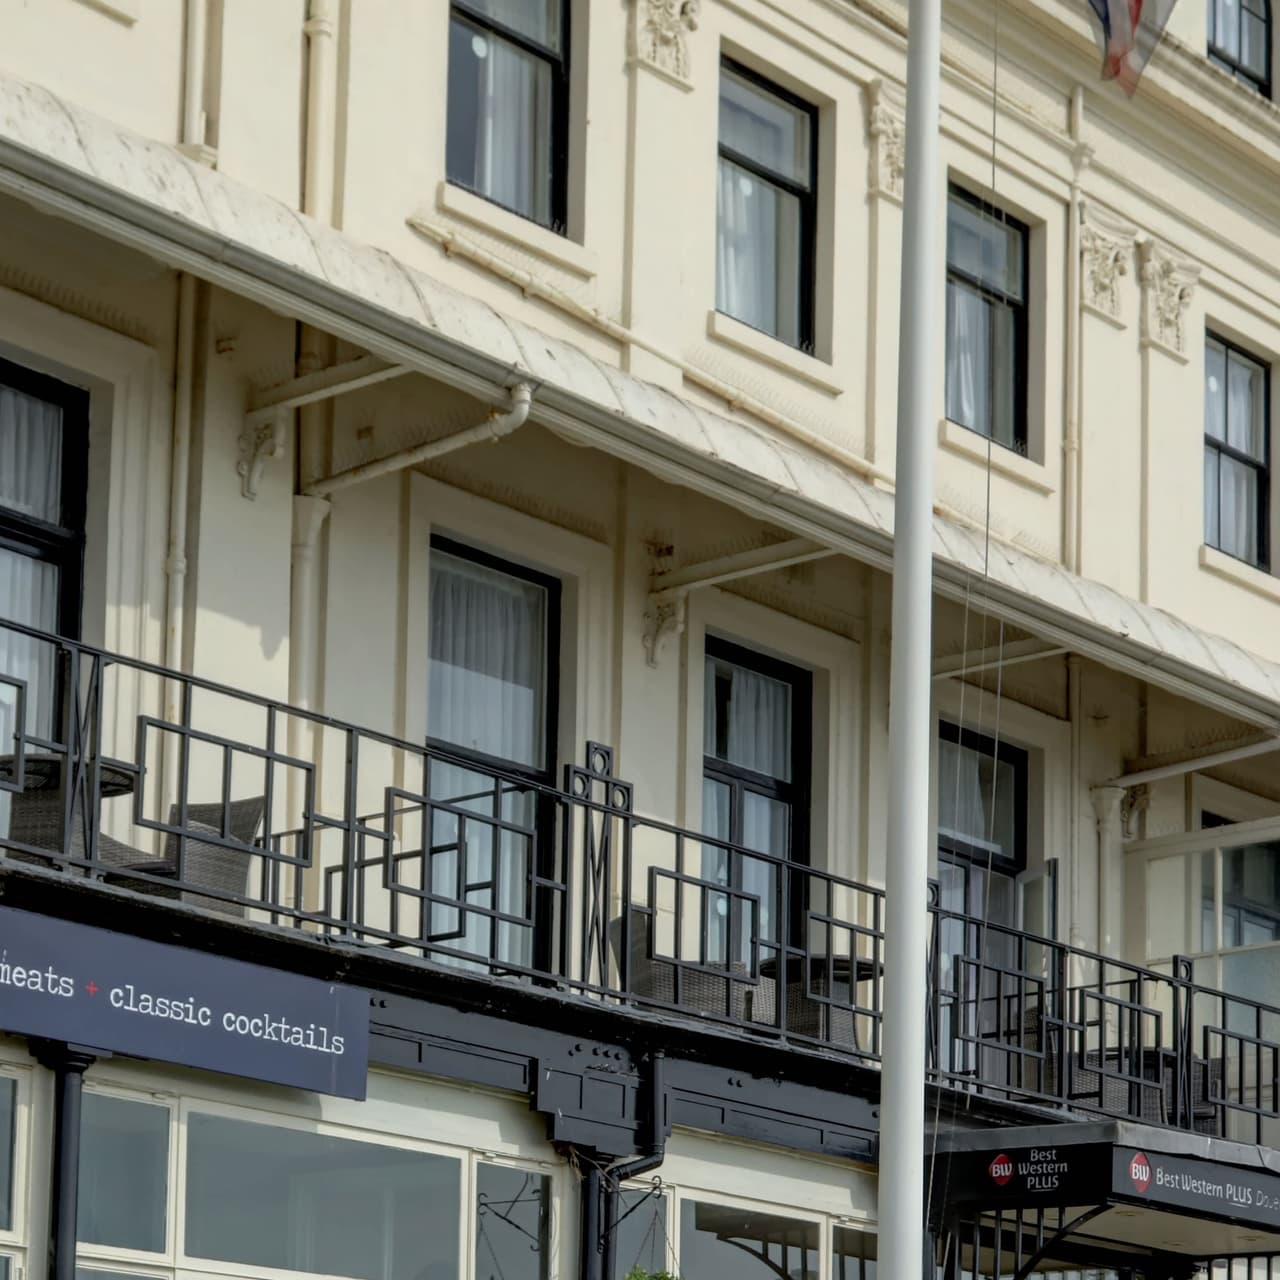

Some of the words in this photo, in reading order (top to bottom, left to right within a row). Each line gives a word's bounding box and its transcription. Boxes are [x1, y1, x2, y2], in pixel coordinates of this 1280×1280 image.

[109, 984, 212, 1028] classic
[222, 1011, 346, 1056] cocktails
[1030, 1149, 1057, 1161] Best
[992, 1163, 1013, 1177] BW
[1018, 1162, 1068, 1175] Western
[1131, 1163, 1150, 1181] BW
[1027, 1175, 1059, 1189] PLUS
[1156, 1168, 1180, 1189] Best
[1181, 1174, 1223, 1198] Western
[1226, 1183, 1253, 1204] PLUS
